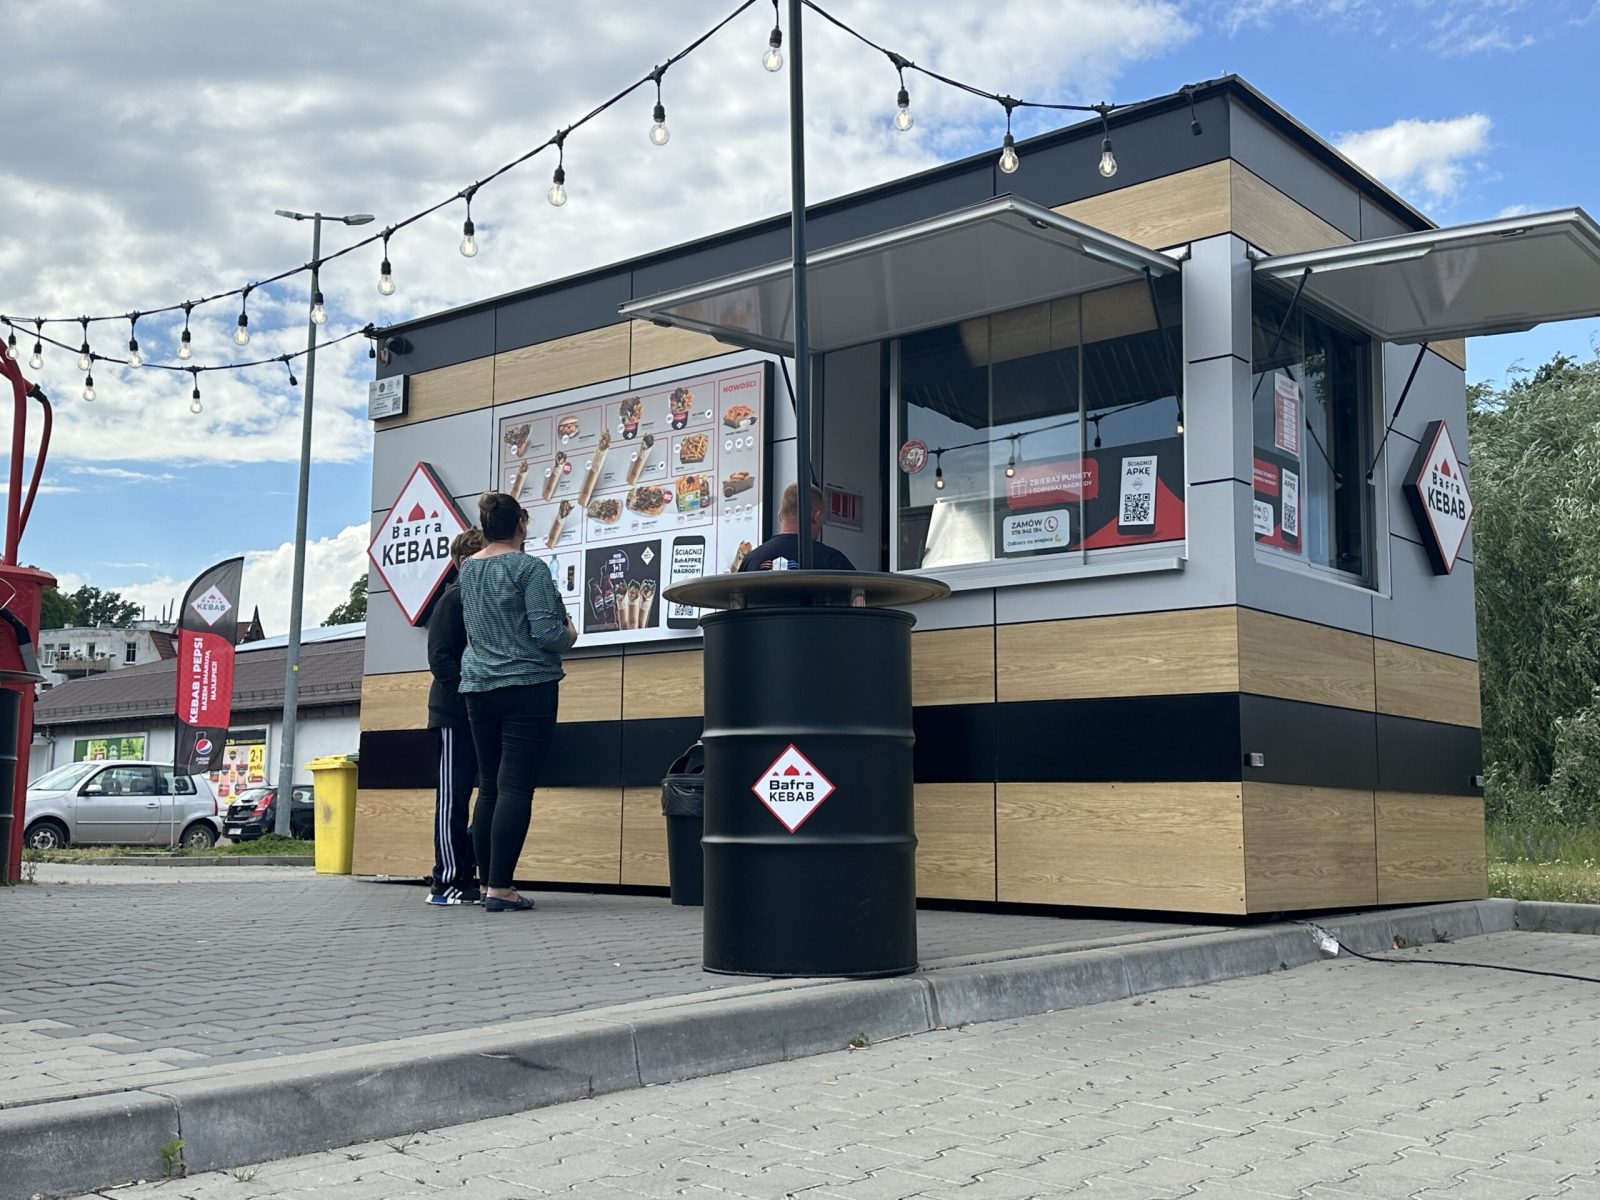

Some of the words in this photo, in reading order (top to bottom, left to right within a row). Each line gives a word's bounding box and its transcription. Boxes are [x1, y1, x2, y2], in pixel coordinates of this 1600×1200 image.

[723, 380, 756, 392] NOWOŚCI
[1126, 467, 1151, 476] APKĘ
[1029, 476, 1060, 486] ZBIERAJ
[1432, 471, 1460, 495] Bafra
[1427, 486, 1466, 520] KEBAB
[1011, 519, 1043, 529] ZAMÓW
[392, 522, 442, 539] Bafra
[382, 536, 450, 567] KEBAB
[674, 548, 703, 557] ŚCIĄGNIJ
[197, 604, 226, 612] KEBAB
[192, 637, 204, 673] PEPSI
[189, 681, 200, 724] KEBAB
[770, 779, 814, 790] Bafra
[770, 792, 814, 802] KEBAB
